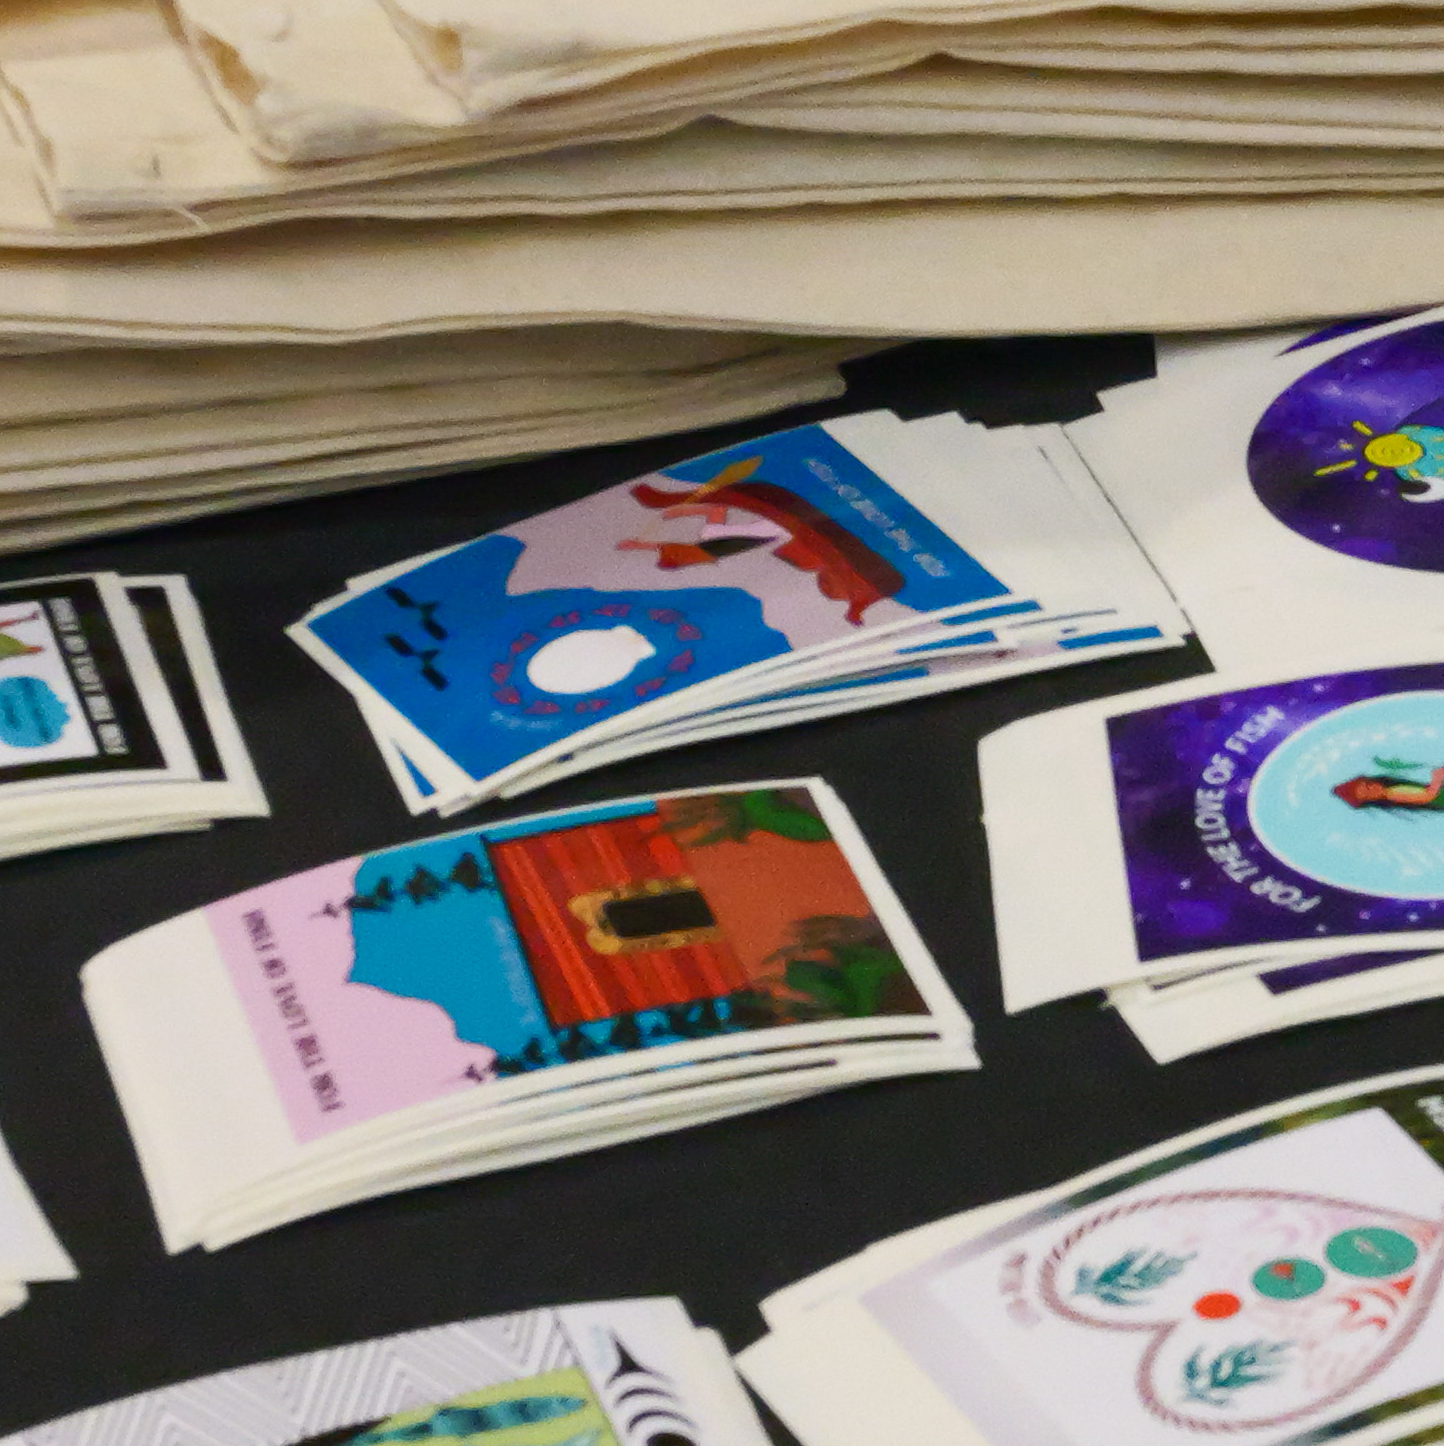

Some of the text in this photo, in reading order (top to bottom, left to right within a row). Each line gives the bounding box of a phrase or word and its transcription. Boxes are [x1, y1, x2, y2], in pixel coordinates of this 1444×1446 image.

[1194, 705, 1323, 914] FOR THE LOVE OF FISH
